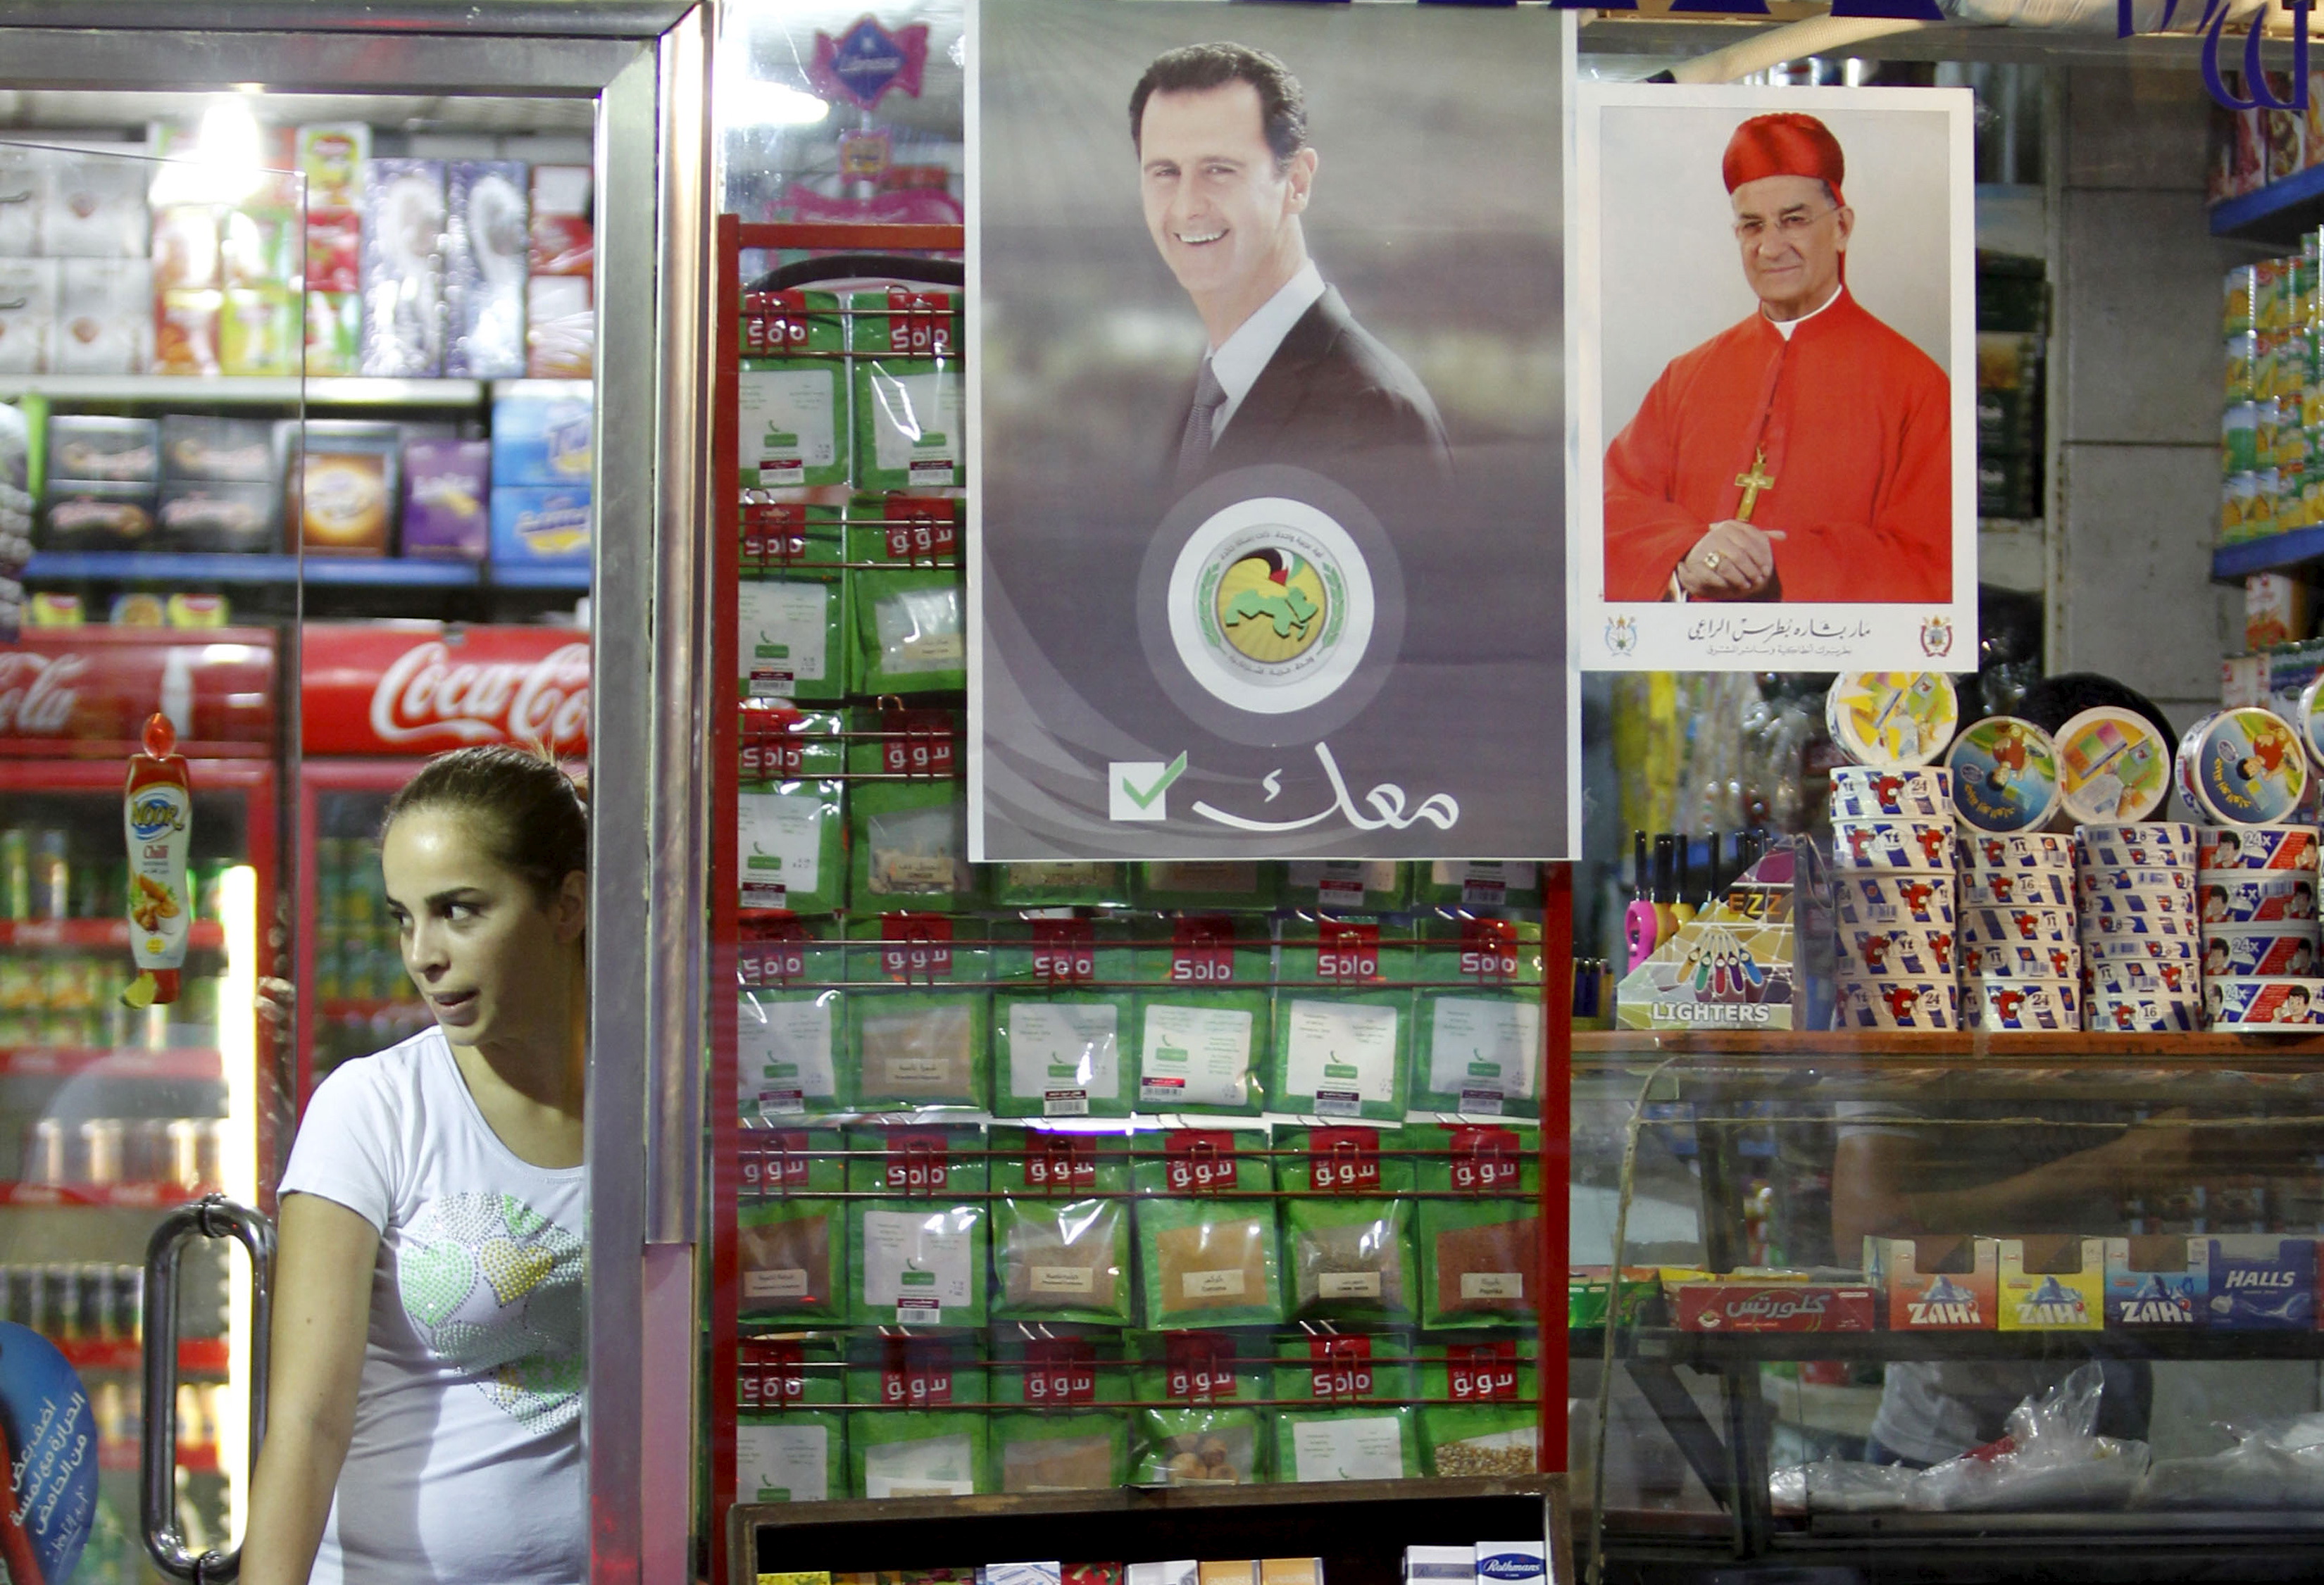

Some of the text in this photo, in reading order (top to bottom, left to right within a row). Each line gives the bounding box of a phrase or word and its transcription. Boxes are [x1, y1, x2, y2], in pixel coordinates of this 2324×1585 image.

[749, 325, 805, 344] Soo
[892, 528, 951, 553] سوو
[1688, 617, 1730, 639] الراعي
[1733, 616, 1792, 644] بطرس
[508, 642, 589, 741] Co
[889, 745, 949, 769] سوو
[1192, 741, 1458, 831] معك
[1911, 779, 1928, 791] 24
[131, 801, 185, 831] NOOR
[2243, 830, 2272, 846] 24x
[2021, 879, 2035, 889] 16
[1729, 893, 1782, 915] EZZ
[2232, 937, 2259, 953] 24x
[887, 949, 947, 970] سوو
[1035, 956, 1090, 978] Soo
[1173, 959, 1230, 981] Solo
[1319, 954, 1375, 976] Solo
[1462, 953, 1515, 974] Solo
[1925, 994, 1939, 1005] 24
[2032, 994, 2050, 1006] 24
[1652, 1003, 1770, 1022] LIGHTERS
[2144, 1007, 2157, 1017] 16
[744, 1160, 804, 1183] سوو
[888, 1165, 944, 1186] Solo
[1030, 1158, 1093, 1182] سوو
[1173, 1160, 1231, 1187] سوو
[1316, 1160, 1375, 1186] سوو
[1457, 1162, 1515, 1186] سوو
[2225, 1270, 2297, 1289] HALLS
[1726, 1295, 1831, 1319] كلورتس
[744, 1377, 800, 1399] Soo
[887, 1375, 947, 1400] سوو
[1030, 1374, 1089, 1397] سوو
[1173, 1370, 1230, 1393] سوو
[1313, 1372, 1370, 1393] Solo
[49, 1392, 86, 1451] الحرارة
[71, 1434, 87, 1467] من
[40, 1451, 55, 1478] مع
[36, 1459, 73, 1535] الحامض
[1483, 1558, 1541, 1573] Rothmans
